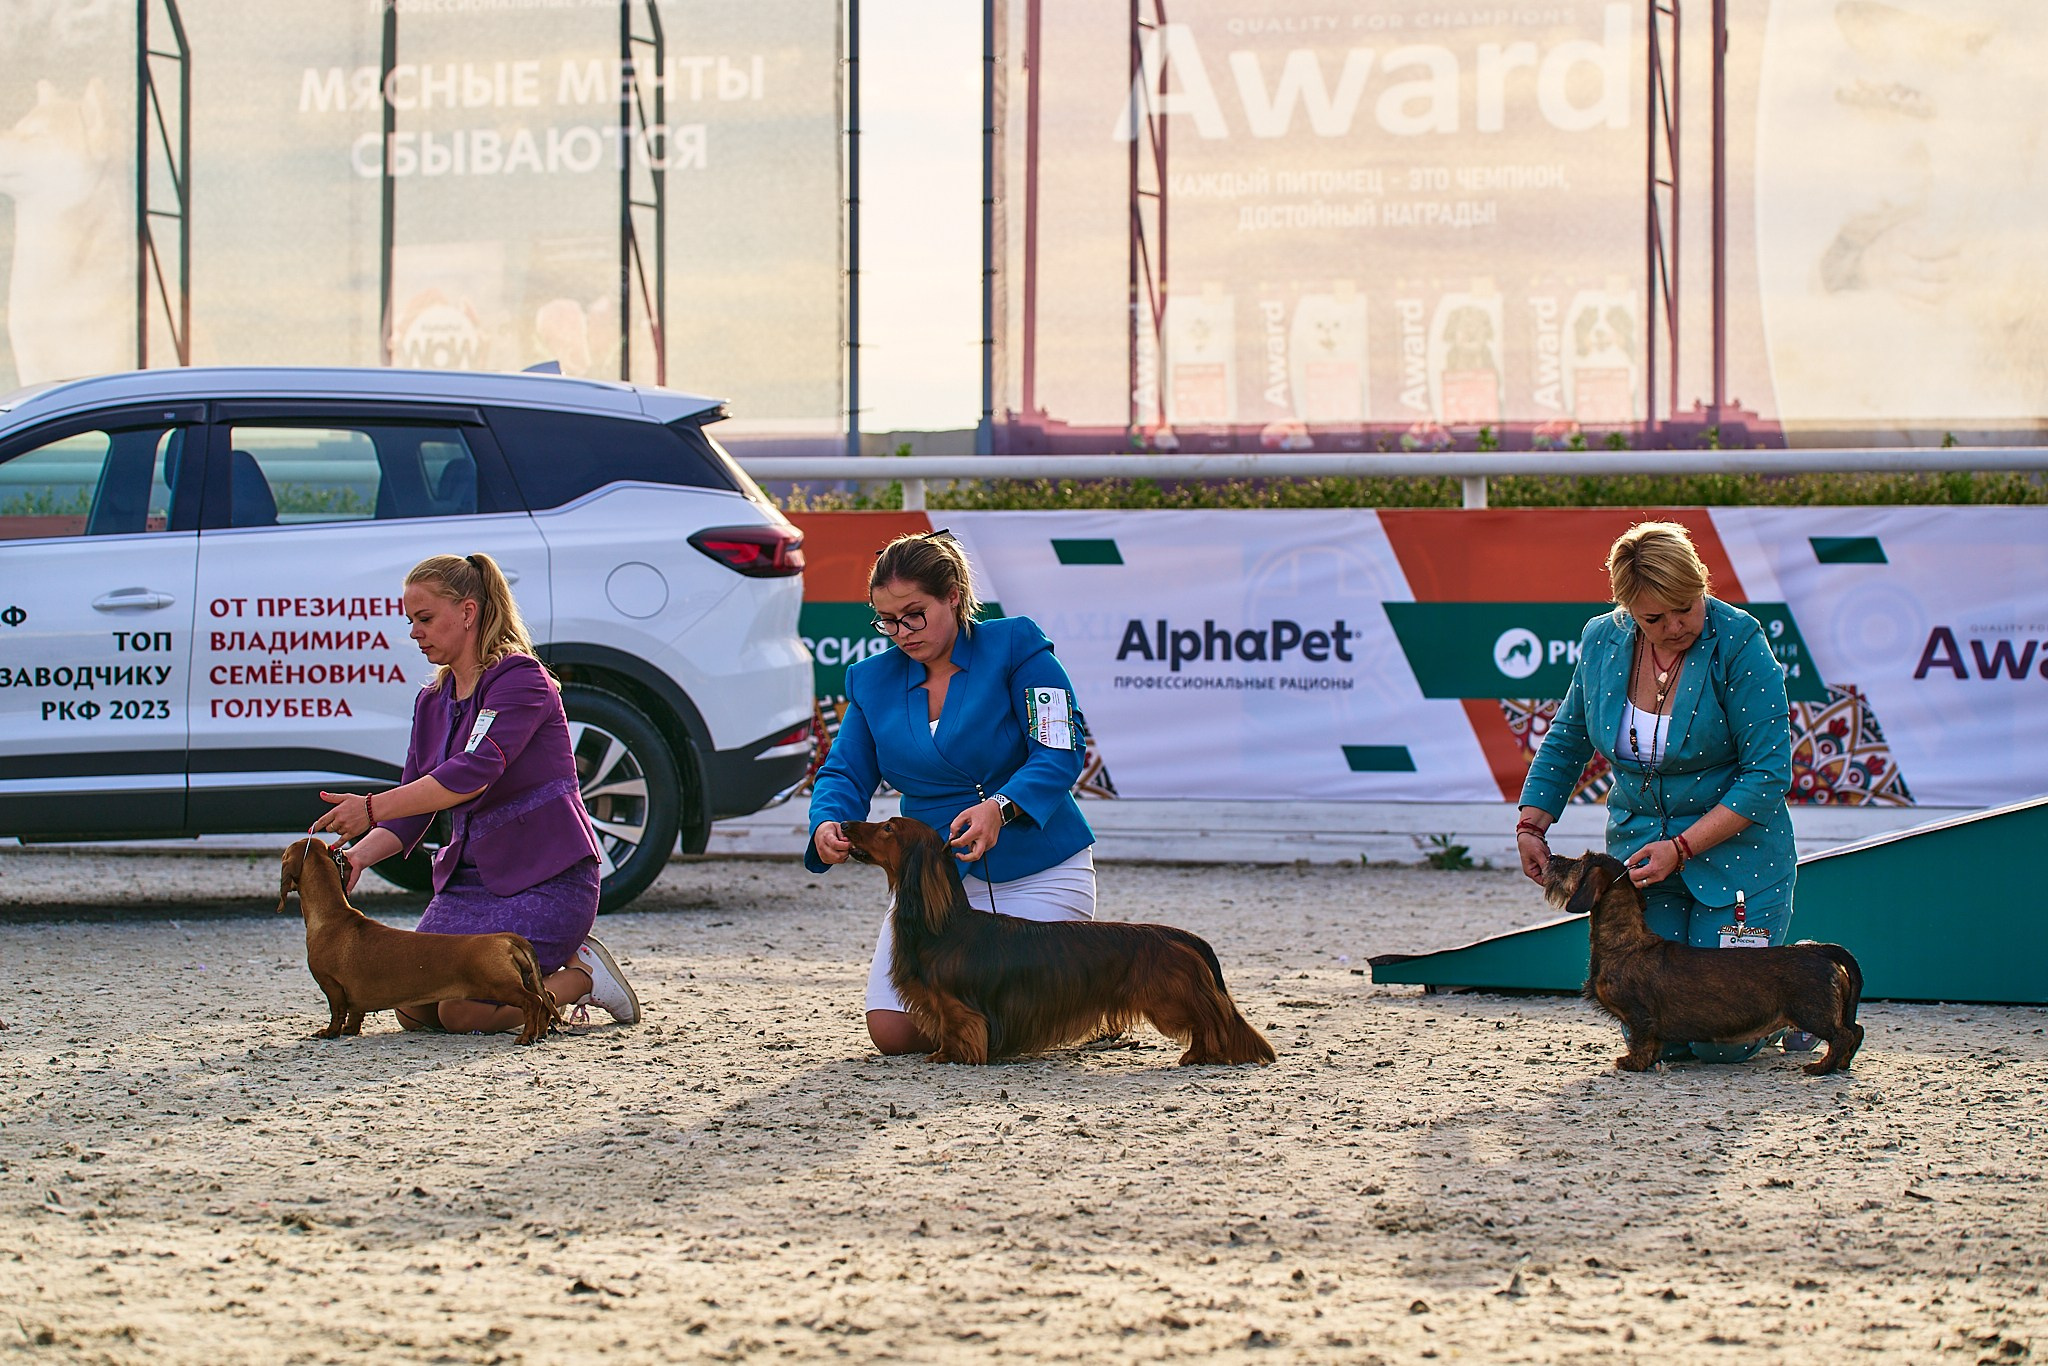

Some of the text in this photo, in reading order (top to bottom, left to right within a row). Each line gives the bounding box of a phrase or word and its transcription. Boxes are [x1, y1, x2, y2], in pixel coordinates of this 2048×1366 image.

[1227, 7, 1578, 35] QUALITY FOR CHAMPIONS
[299, 55, 764, 113] МЯСНЫЕ МЕЧТЫ
[1112, 3, 1632, 141] Award
[351, 123, 707, 178] СБЫВАЮТСЯ
[1168, 168, 1270, 199] КАЖДЫЙ
[1277, 169, 1384, 195] ПИТОМЕЦ
[1409, 168, 1450, 192] ЭТО
[1237, 199, 1377, 231] ДОСТОЙНЫЙ
[1260, 300, 1288, 409] Award
[1395, 297, 1428, 412] Award
[1529, 296, 1562, 411] Award
[0, 606, 27, 627] Ф
[210, 598, 404, 621] ОТ ПРЕЗИДЕН
[112, 632, 172, 651] ТОП
[1970, 623, 2024, 634] QUALITY
[210, 631, 390, 655] ВЛАДИМИРА
[1115, 619, 1353, 672] AlphaPet
[1548, 639, 1582, 665] РК
[0, 665, 172, 691] ЗАВОДЧИКУ
[209, 659, 406, 685] СЕМЁНОВИЧА
[1114, 676, 1354, 691] ПРОФЕССИОНАЛЬНЫЕ РАЦИОНЫ
[41, 700, 170, 721] РКФ 2023
[210, 698, 353, 718] ГОЛУБЕВА
